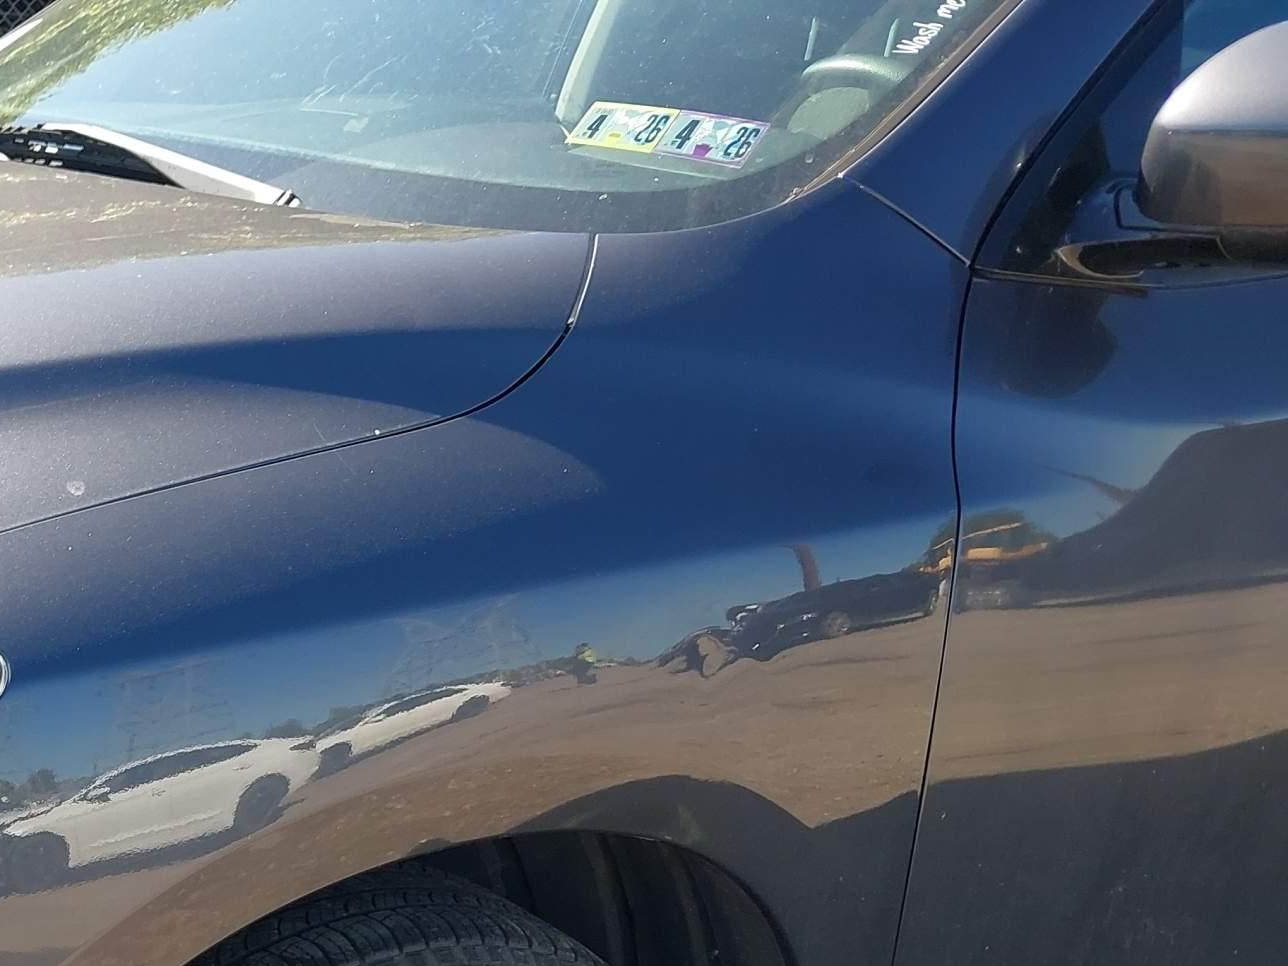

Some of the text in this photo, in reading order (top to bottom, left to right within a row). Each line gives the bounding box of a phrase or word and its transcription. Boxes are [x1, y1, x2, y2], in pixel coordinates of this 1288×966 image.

[892, 22, 943, 53] Wash
[586, 114, 670, 144] 4 26
[675, 119, 760, 158] 4 26
